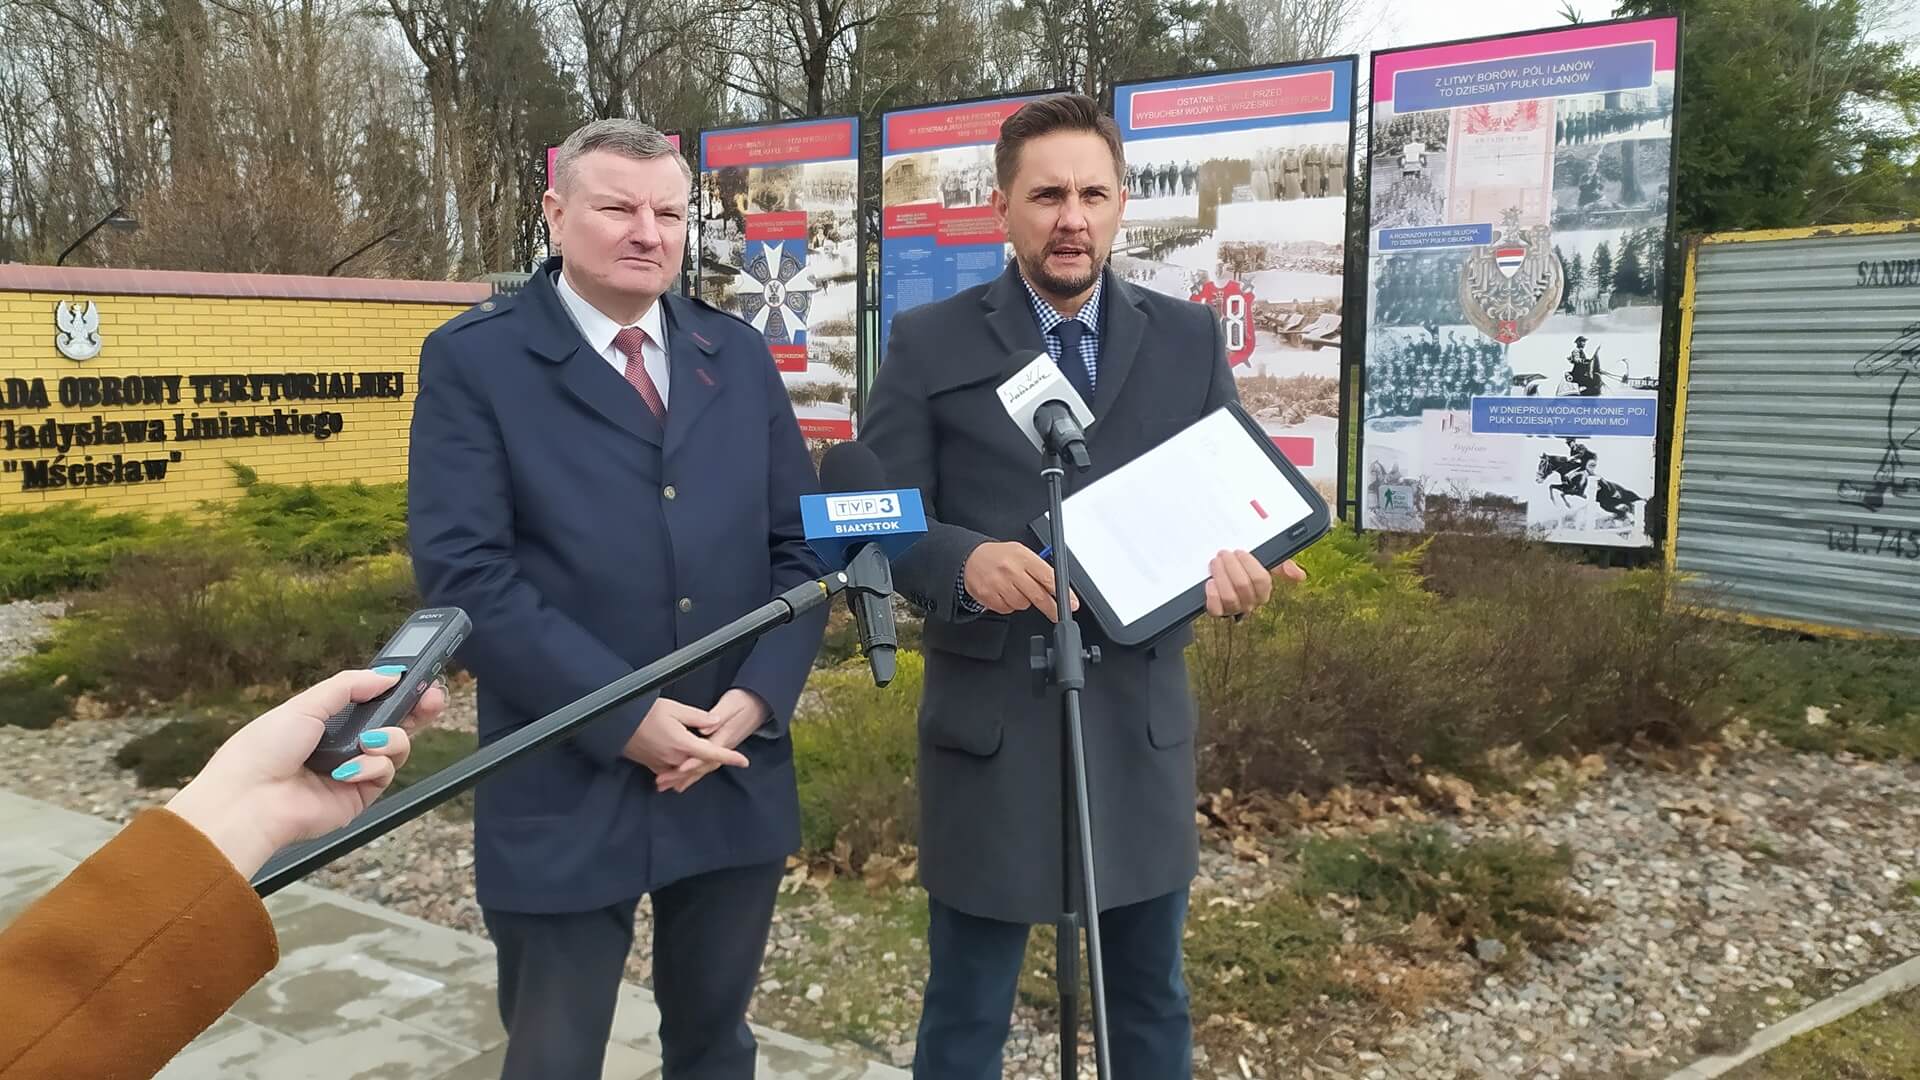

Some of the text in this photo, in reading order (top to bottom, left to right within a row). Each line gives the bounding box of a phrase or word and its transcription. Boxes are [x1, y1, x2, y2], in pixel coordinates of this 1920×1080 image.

[1434, 78, 1442, 87] Z
[1444, 73, 1475, 86] LITWY
[1522, 64, 1545, 77] PÓL
[1440, 70, 1591, 97] TO DZIESIĄTY PUŁK UŁANÓW
[1176, 94, 1217, 106] OSTATNIE
[1253, 87, 1282, 98] PRZED
[1136, 108, 1184, 120] WYBUCHEM
[1185, 103, 1214, 115] WOJNY
[1216, 102, 1229, 112] WE
[58, 373, 184, 408] OBRONY
[189, 371, 404, 404] TERYTORIALNEJ
[1489, 405, 1499, 414] W
[1500, 405, 1543, 415] DNIEPRU
[1545, 406, 1591, 415] WODACH
[1593, 407, 1625, 416] KONIE
[1489, 415, 1514, 425] PUŁK
[1516, 416, 1565, 426] DZIESIĄTY
[1574, 416, 1606, 426] POMNI
[0, 408, 344, 453] ładysława Liniarskiego
[3, 450, 183, 491] "Mścisław"
[835, 520, 900, 534] BIAŁYSTOK
